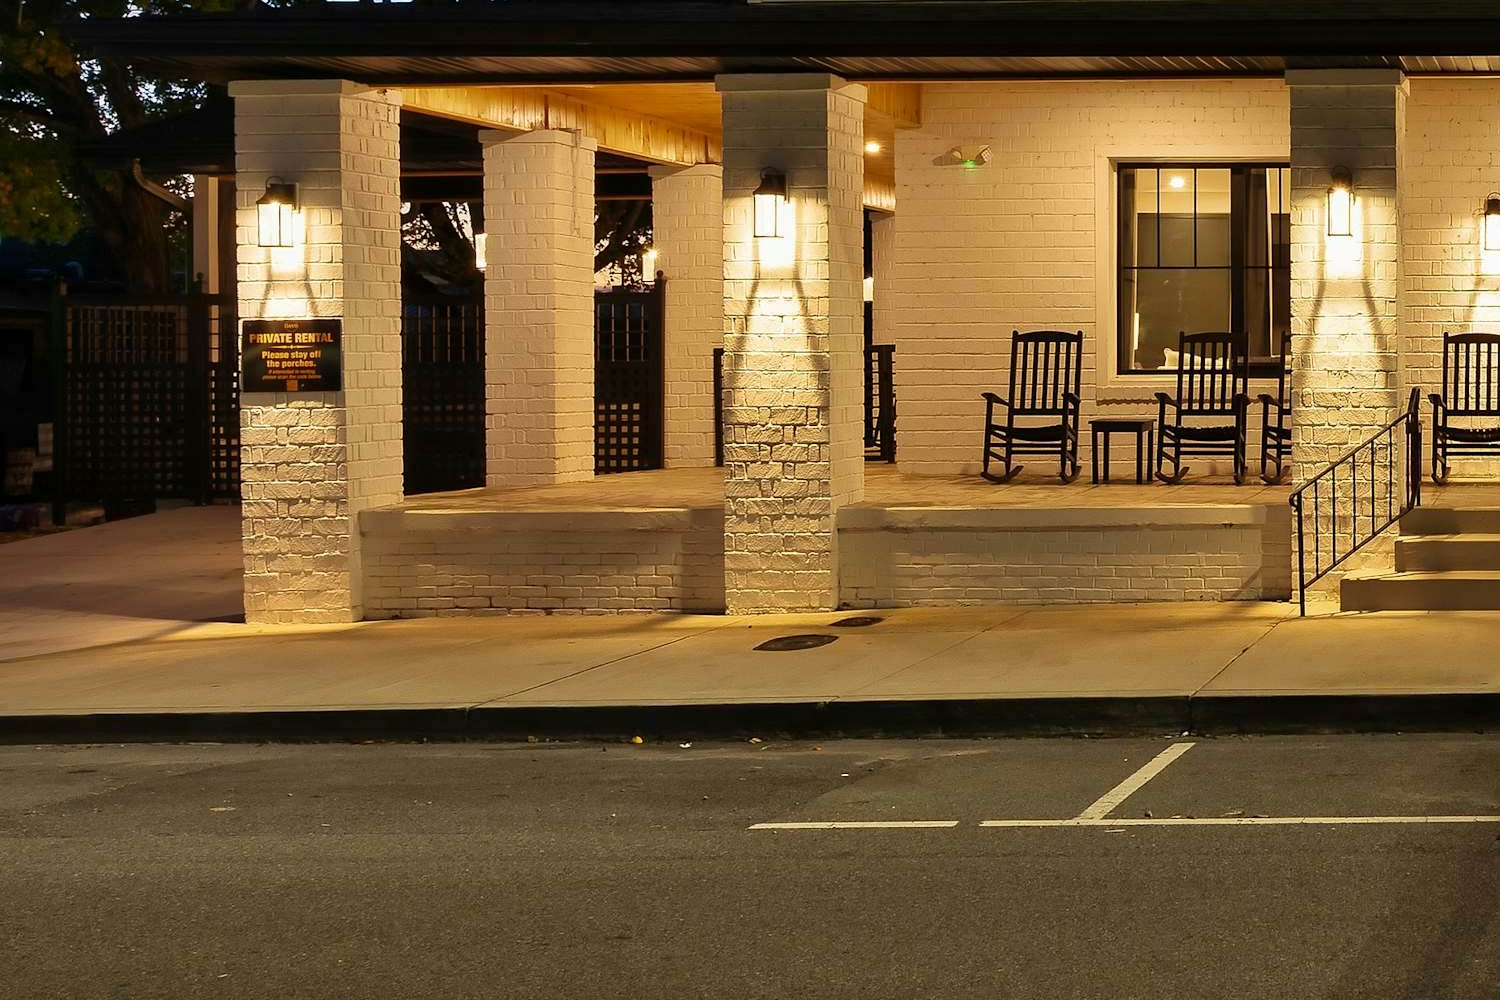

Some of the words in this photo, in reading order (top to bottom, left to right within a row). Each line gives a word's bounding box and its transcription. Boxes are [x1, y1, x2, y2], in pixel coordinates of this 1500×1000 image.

[248, 332, 293, 344] PRIVATE
[294, 332, 334, 343] RENTAL
[261, 350, 290, 359] Please
[290, 350, 308, 360] stay
[309, 350, 321, 358] off
[266, 360, 281, 368] the
[281, 359, 317, 369] porches.
